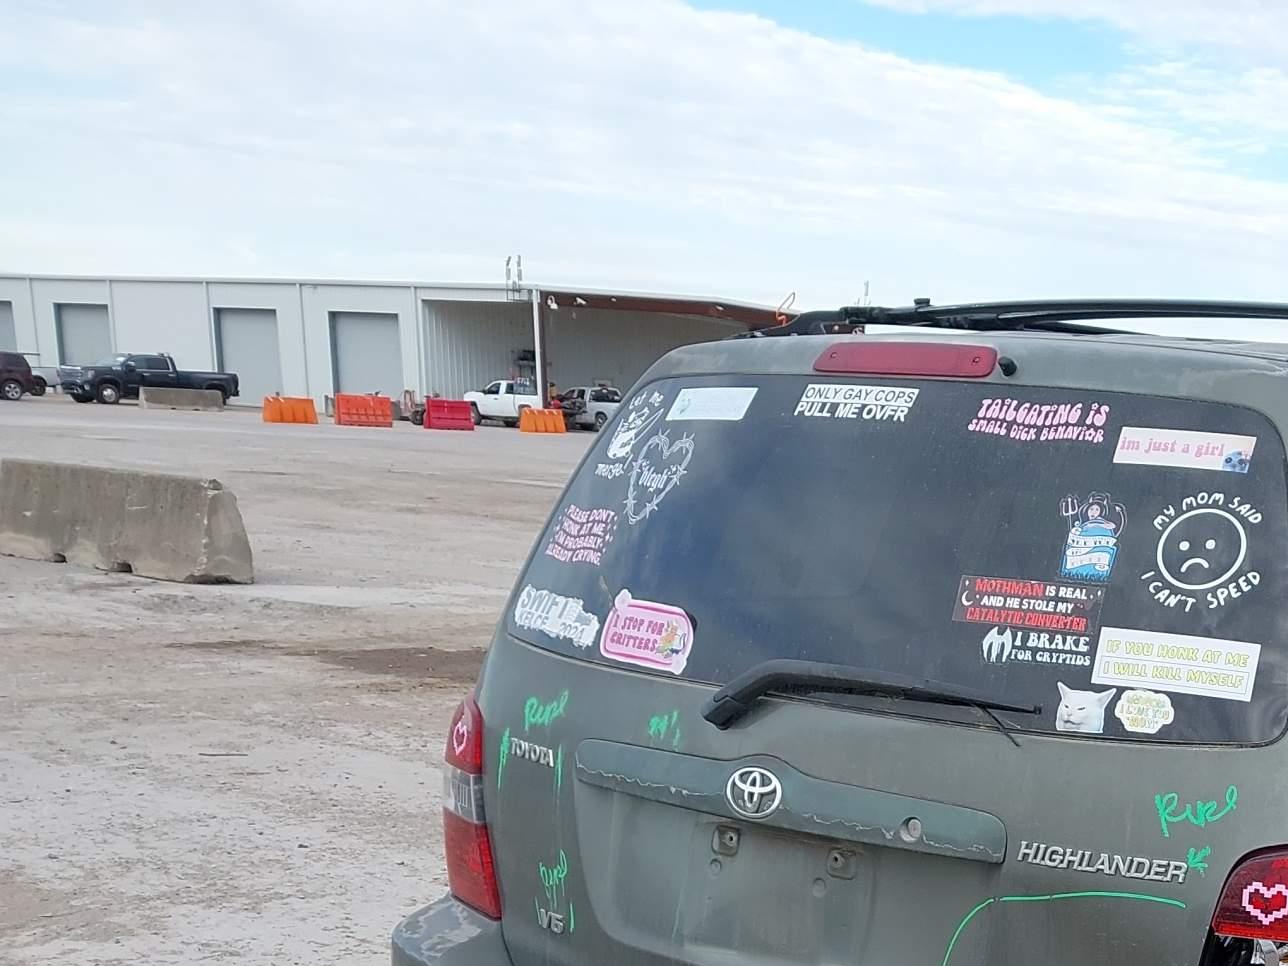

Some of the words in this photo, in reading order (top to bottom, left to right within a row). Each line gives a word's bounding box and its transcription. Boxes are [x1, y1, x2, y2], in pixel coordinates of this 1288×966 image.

[805, 386, 843, 399] ONLY
[843, 388, 873, 400] GAY
[874, 390, 916, 404] COPS
[793, 402, 832, 417] PULL
[834, 403, 862, 418] ME
[967, 419, 1008, 435] SMALL
[1144, 438, 1178, 454] just
[1181, 443, 1190, 453] a
[1195, 442, 1224, 458] girl
[566, 504, 591, 522] PLEASE
[1153, 504, 1175, 530] MY
[1182, 492, 1225, 511] MOM
[1228, 497, 1262, 524] SAID
[975, 578, 1044, 596] MOTHMAN
[1045, 585, 1057, 597] IS
[1059, 587, 1087, 600] REAL
[1141, 571, 1155, 580] I
[1149, 581, 1197, 612] CAN'T
[1206, 571, 1260, 609] SPEED
[980, 595, 1005, 607] AND
[1005, 597, 1020, 609] HE
[1021, 599, 1055, 612] STOLE
[1056, 602, 1075, 613] MY
[612, 614, 619, 628] I
[621, 616, 644, 632] STOP
[645, 620, 665, 636] FOR
[966, 607, 1024, 626] CATALYTIC
[1025, 612, 1087, 631] CONVERTER
[609, 631, 658, 651] CRITTERS
[1014, 631, 1022, 646] I
[1026, 632, 1090, 652] BRAKE
[1010, 649, 1033, 661] FOR
[1036, 650, 1091, 666] CRYPTIDS
[1106, 639, 1121, 653] IF
[1125, 641, 1153, 657] YOU
[1157, 644, 1199, 661] HONK
[1202, 649, 1222, 664] AT
[1225, 652, 1249, 667] ME
[1103, 661, 1109, 674] I
[1113, 662, 1147, 677] WILL
[1152, 665, 1182, 680] KILL
[1186, 669, 1243, 688] MYSELF
[510, 736, 554, 768] TOYOTA
[1017, 840, 1189, 883] HIGHLANDER
[539, 908, 565, 934] V6
